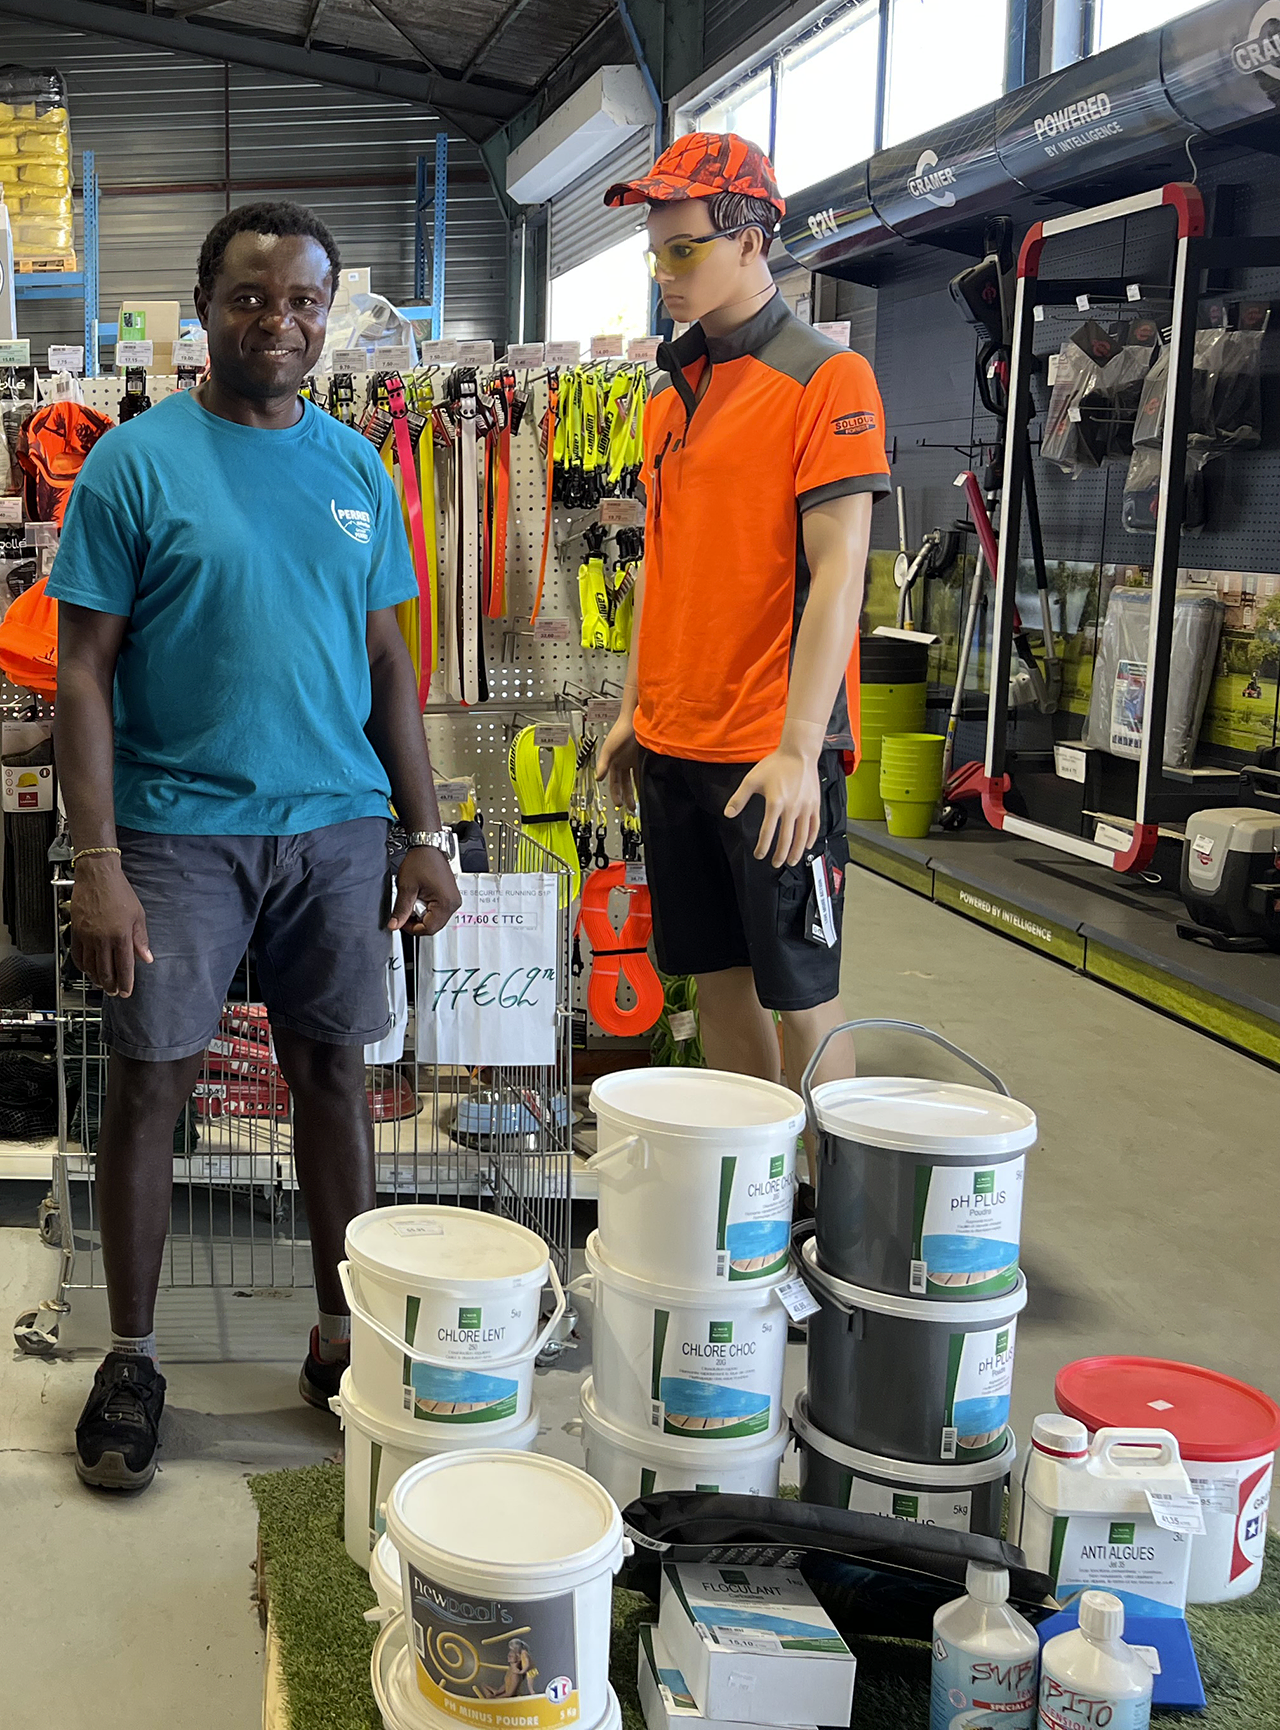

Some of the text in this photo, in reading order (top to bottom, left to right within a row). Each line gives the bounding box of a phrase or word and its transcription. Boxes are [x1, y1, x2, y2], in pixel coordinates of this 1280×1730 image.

[1235, 35, 1280, 70] CRA
[1033, 92, 1112, 142] POWERED
[1043, 121, 1124, 158] BY INTELLIGENCE
[908, 166, 956, 198] CRAMER
[806, 207, 840, 240] 82V
[835, 416, 874, 430] SOLIDUR
[337, 509, 371, 523] PERRET
[454, 914, 524, 926] 117,60 € TTC
[959, 890, 1052, 943] POWERED BY INTELLIGENCE
[747, 1178, 781, 1198] CHLORE
[950, 1190, 1007, 1212] pH PLUS
[437, 1326, 506, 1343] CHLORE LENT
[681, 1341, 757, 1358] CHLORE CHOC
[978, 1356, 994, 1376] pH
[952, 1504, 969, 1516] 5kg
[1080, 1545, 1156, 1561] ANTI ALGUES
[701, 1582, 782, 1596] FLOCULANT
[728, 1639, 754, 1647] 15,10
[443, 1697, 539, 1726] PH MINUS POUDRE
[560, 1711, 565, 1720] 5
[990, 1702, 1025, 1712] SPÉCIAL
